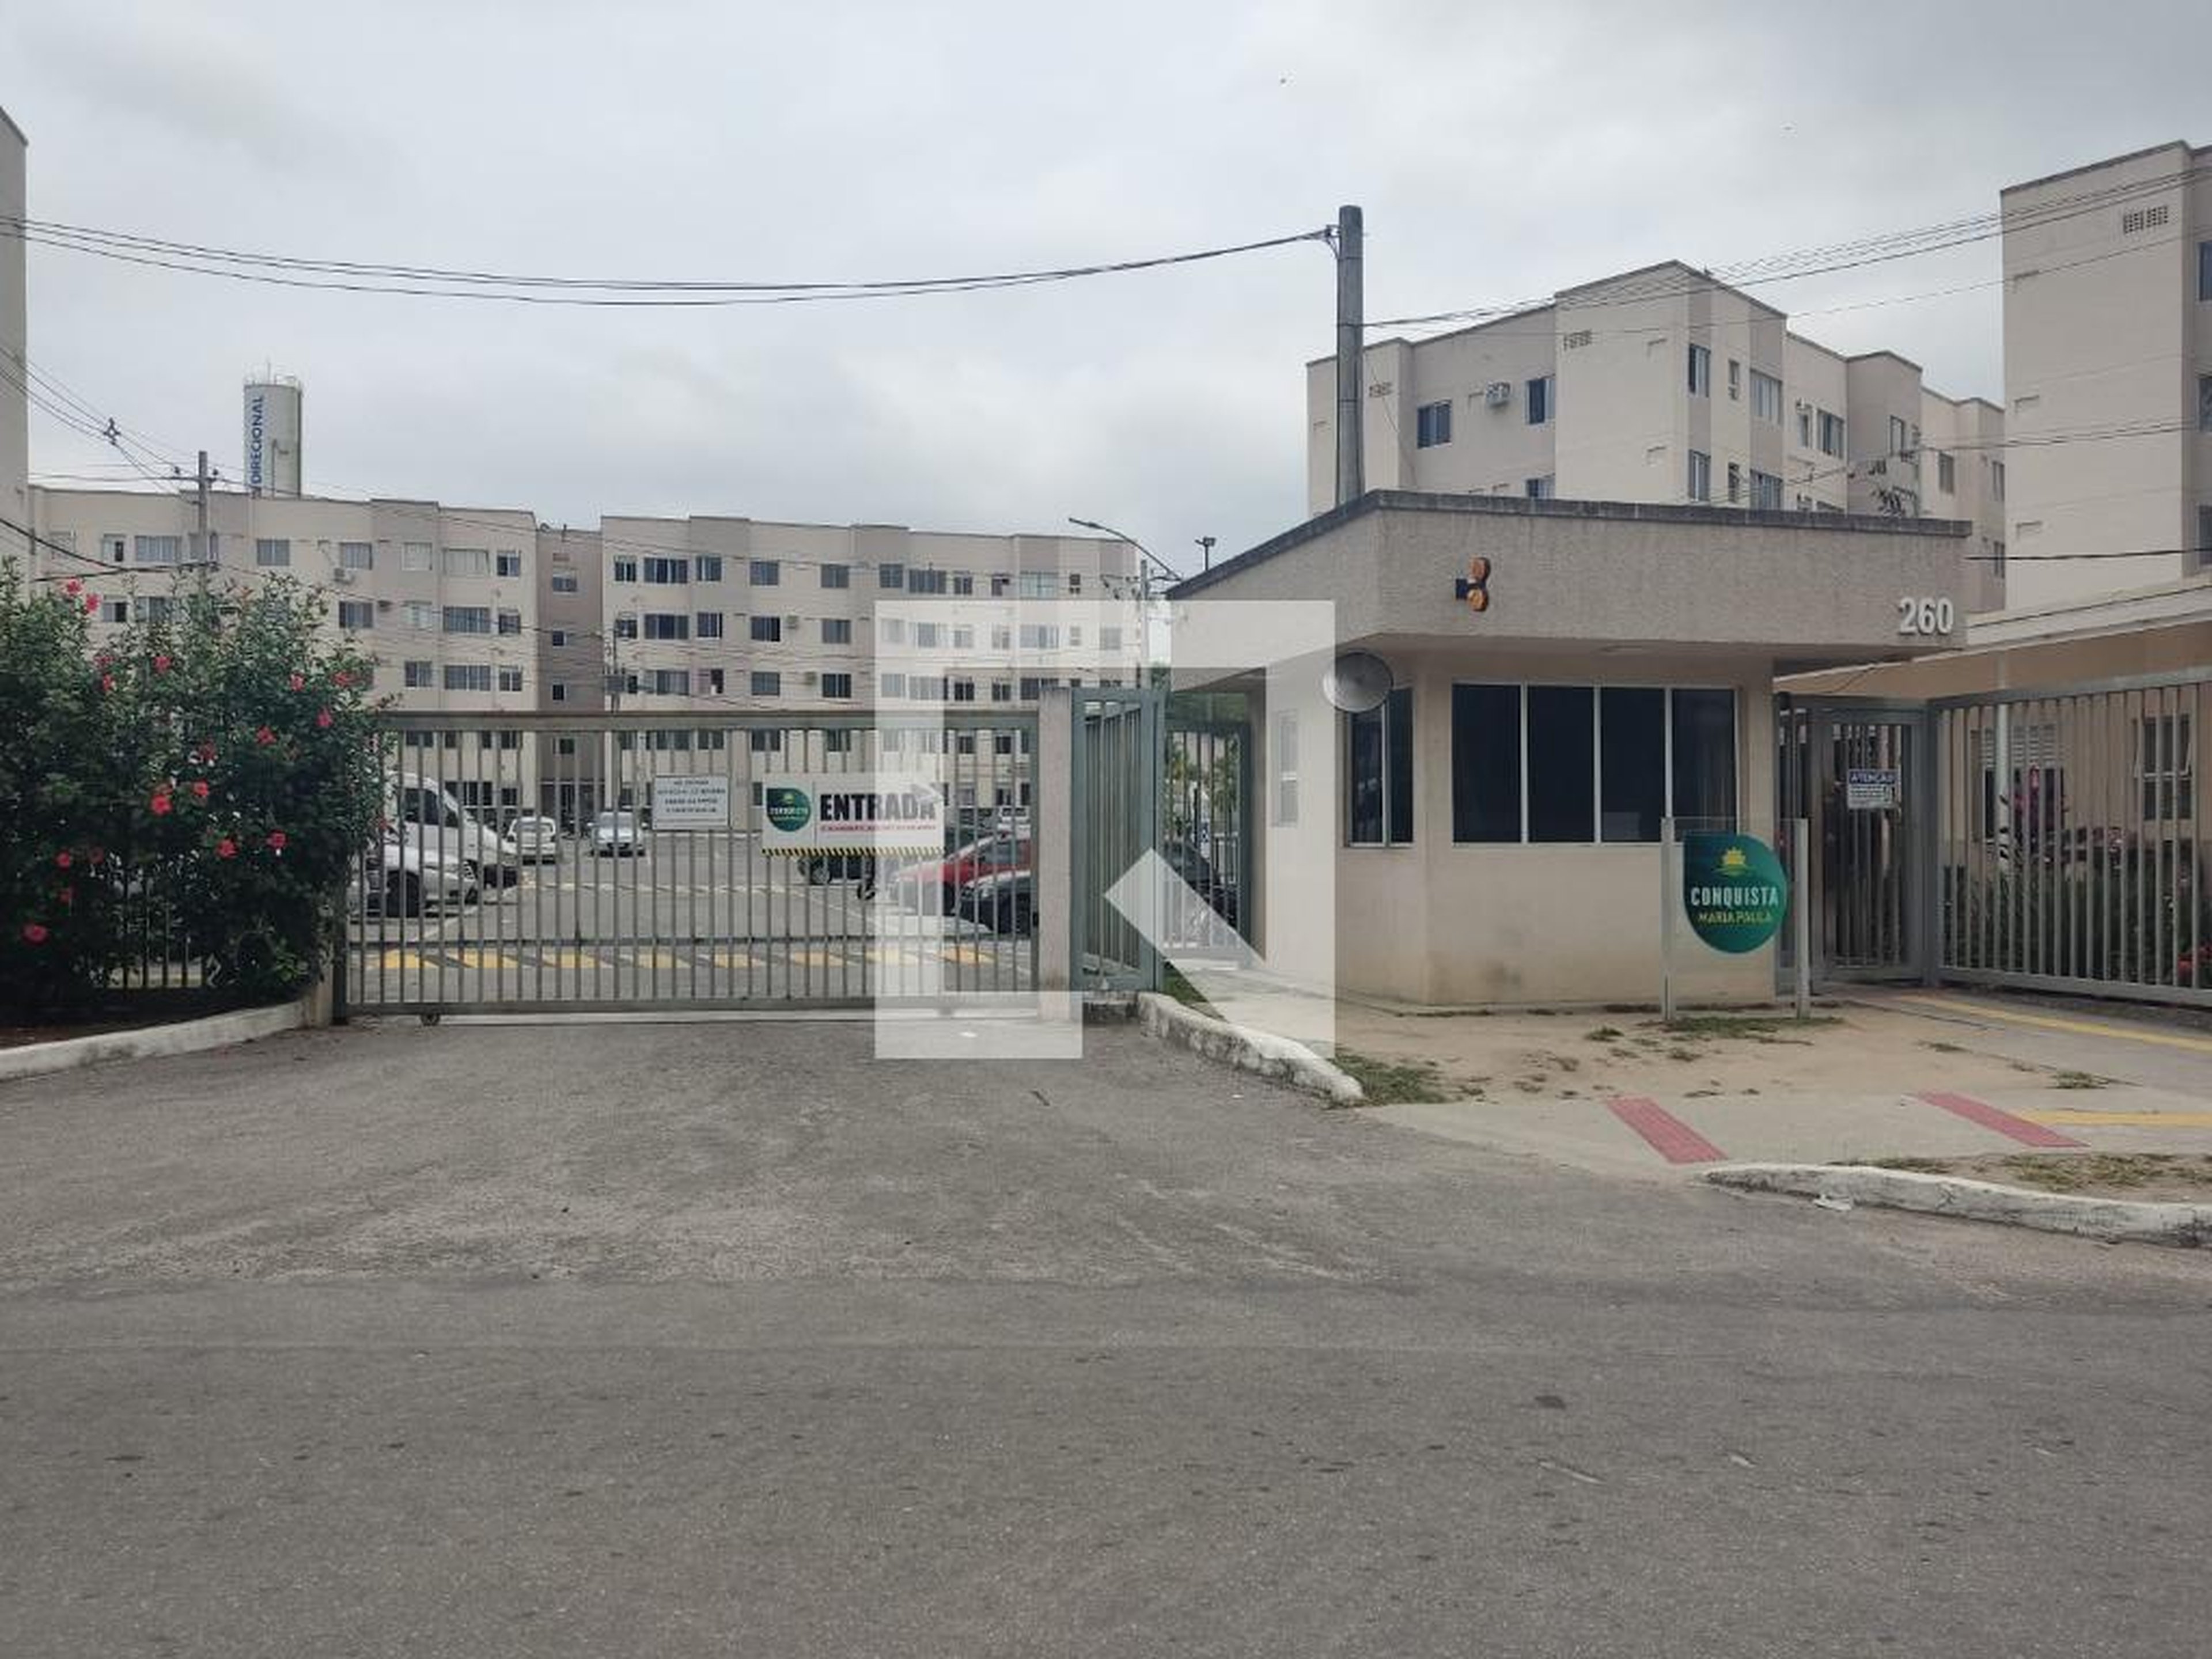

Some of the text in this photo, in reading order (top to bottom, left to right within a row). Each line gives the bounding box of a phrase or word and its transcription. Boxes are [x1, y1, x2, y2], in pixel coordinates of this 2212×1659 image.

[250, 395, 263, 484] DIRECIONAL
[1899, 597, 1953, 635] 260
[820, 793, 937, 821] ENTRADA
[1691, 887, 1779, 908] CONQUISTA
